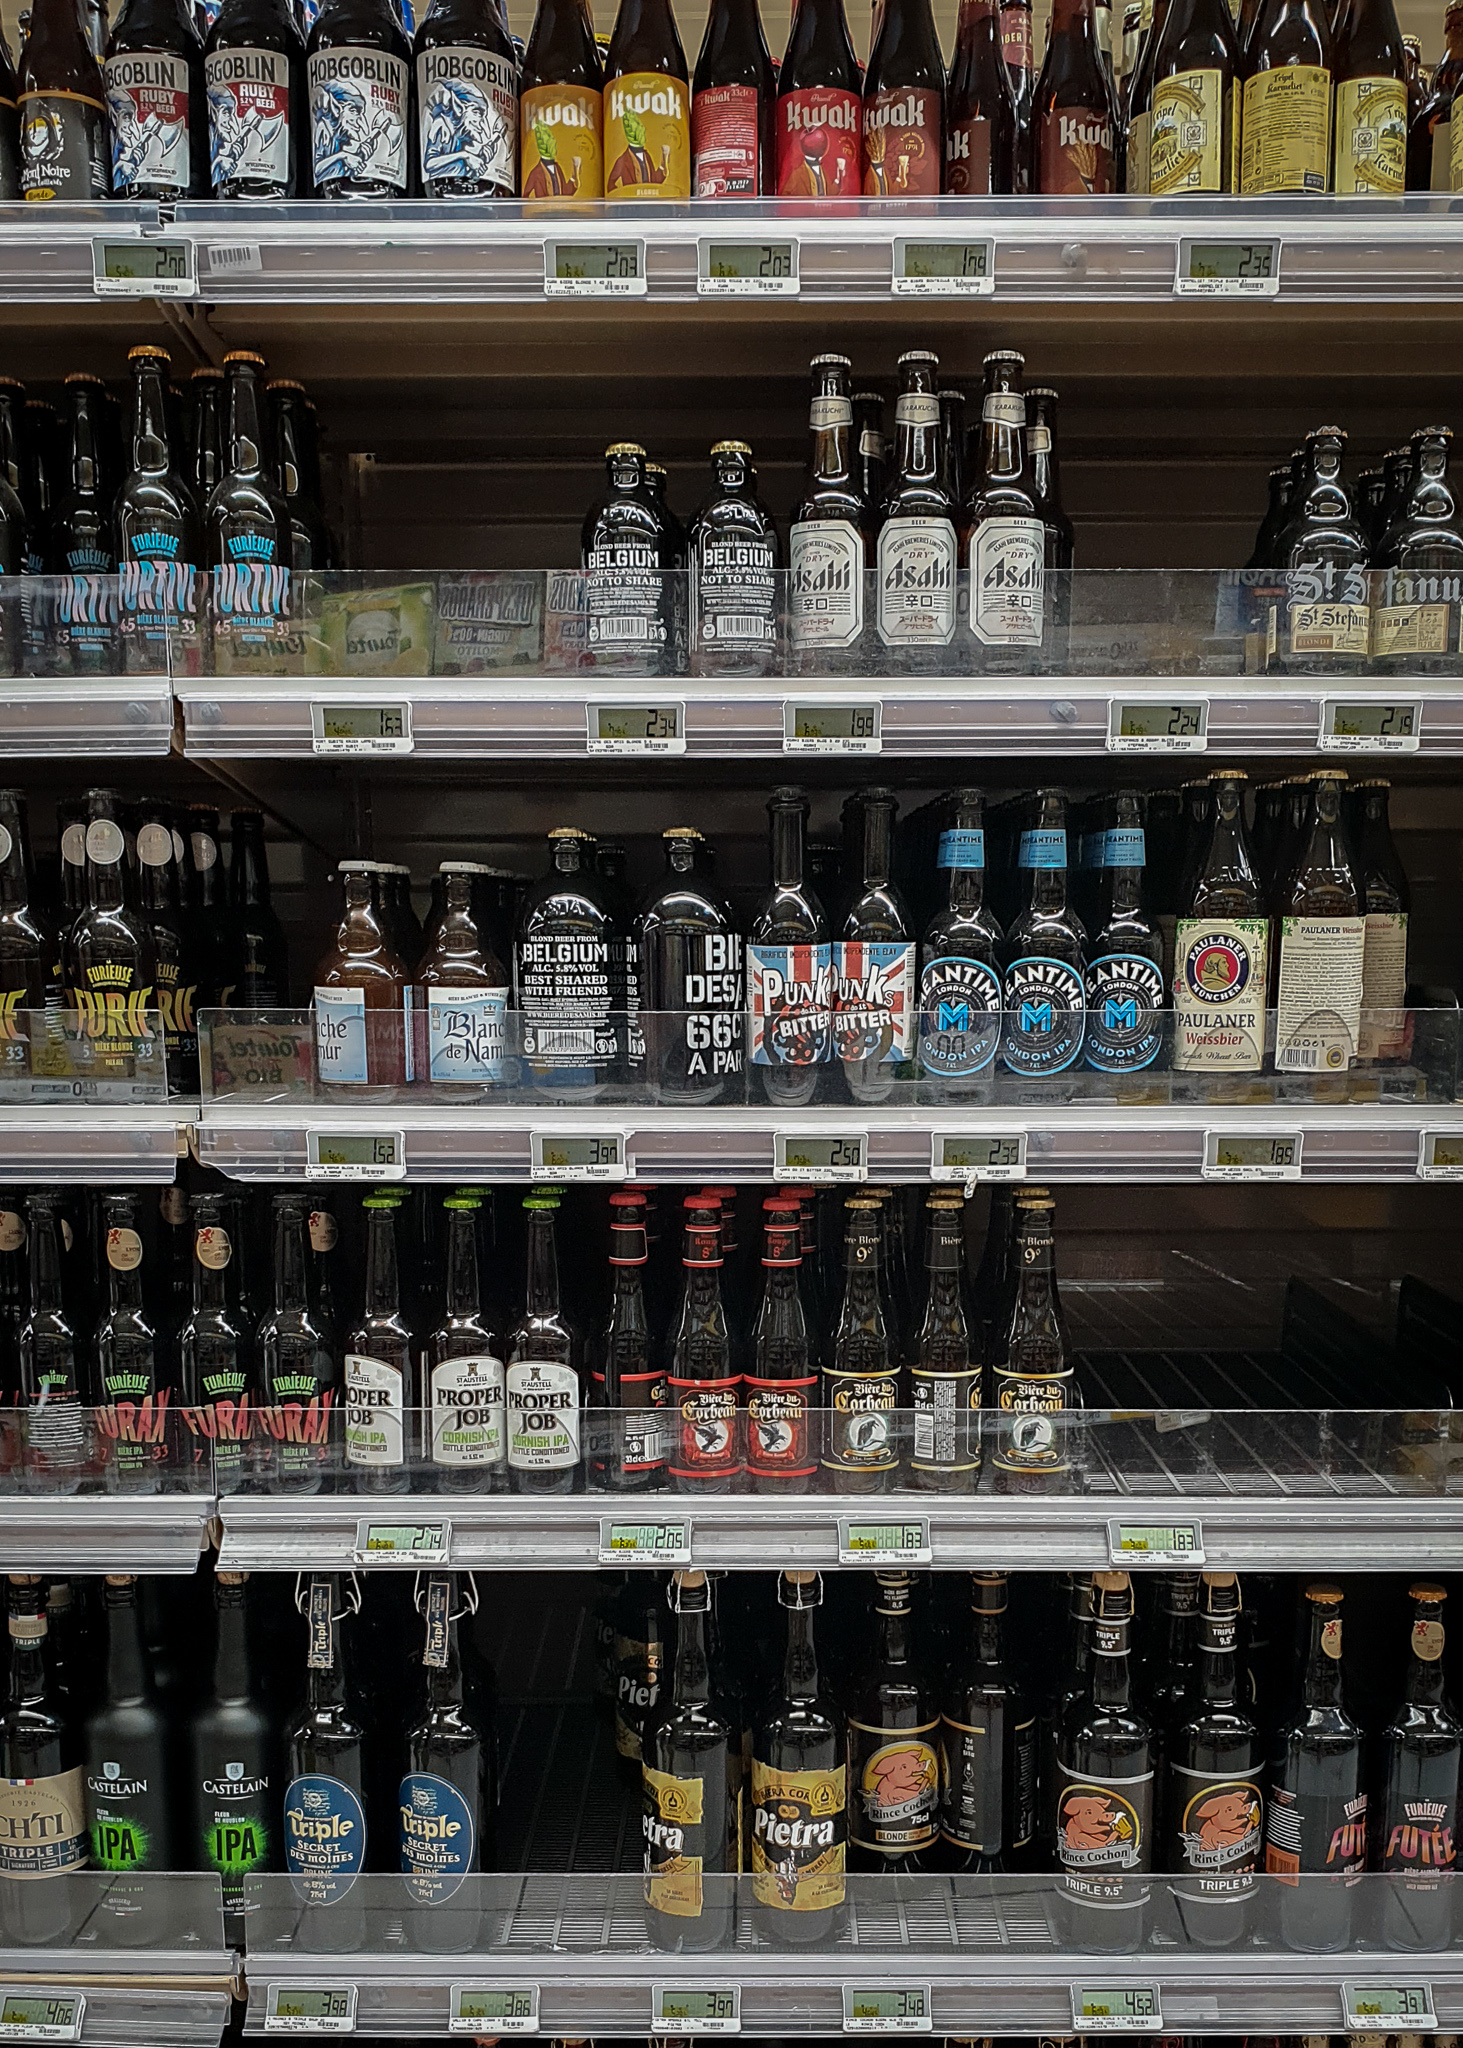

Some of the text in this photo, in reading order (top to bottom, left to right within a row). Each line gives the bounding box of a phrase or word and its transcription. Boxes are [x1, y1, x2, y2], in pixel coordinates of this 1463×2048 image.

[311, 56, 400, 89] HOBGOBLIN
[426, 55, 514, 95] HOBGOBLIN
[139, 89, 175, 105] RUBY
[240, 83, 275, 98] RUBY
[371, 84, 400, 102] RUBY
[155, 104, 176, 115] BEER
[256, 99, 275, 110] BEER
[131, 532, 179, 553] FURIEUSE
[228, 535, 275, 556] FURIEUSE
[589, 551, 659, 568] BELGIUM
[703, 550, 774, 568] BELGIUM
[587, 578, 604, 587] NOT
[626, 577, 662, 587] SHARE
[701, 575, 775, 586] NOT TO SHARE
[791, 559, 850, 594] Asahi
[885, 558, 950, 590] Asahi
[119, 561, 196, 613] FURTIVE
[214, 563, 290, 615] FURTIVE
[804, 598, 827, 611] 辛口
[906, 594, 932, 608] 辛口
[1007, 594, 1032, 608] 辛口
[1301, 926, 1341, 935] PAULANER
[523, 943, 607, 962] BELGIUM
[1189, 935, 1247, 961] PAULANER
[87, 966, 134, 983] FURIEUSE
[532, 964, 554, 972] ALC.
[556, 964, 578, 972] 5.8%
[525, 975, 607, 985] BEST SHARED
[1103, 981, 1139, 994] LONDON
[525, 987, 608, 996] WITH FRIENDS
[936, 983, 972, 995] LONDON
[1019, 983, 1055, 995] LONDON
[1191, 983, 1242, 1002] MÜNCHEN
[74, 986, 155, 1040] FURIE
[836, 1010, 891, 1032] BITTER
[1178, 1013, 1255, 1028] PAULANER
[1088, 1035, 1155, 1058] LONDON IPA
[1186, 1032, 1244, 1046] Weissbier
[6, 1046, 24, 1060] 33
[138, 1044, 152, 1058] 33
[447, 1043, 460, 1059] de
[923, 1036, 989, 1061] LONDON IPA
[1006, 1037, 1072, 1062] LONDON IPA
[106, 1372, 150, 1392] FURIEUSE
[203, 1372, 247, 1392] FURIEUSE
[273, 1372, 318, 1393] FURIEUSE
[436, 1386, 504, 1406] PROPER
[699, 1393, 735, 1403] Bière du
[761, 1393, 800, 1404] Bière du
[854, 1384, 895, 1397] Bière du
[1017, 1384, 1061, 1397] Bière du
[508, 1391, 574, 1410] PROPER
[835, 1391, 895, 1413] Corbeau
[1000, 1391, 1063, 1414] Corbeau
[681, 1401, 736, 1422] Corbeau
[748, 1399, 802, 1423] Corbeau
[454, 1408, 491, 1431] JOB
[520, 1412, 557, 1434] JOB
[370, 1432, 387, 1443] IPA
[442, 1428, 499, 1444] CORNISH IPA
[513, 1434, 569, 1448] CORNISH IPA
[465, 1440, 500, 1451] CONDITIONED
[531, 1446, 570, 1455] CONDITIONED
[1096, 1630, 1120, 1640] TRIPLE
[1212, 1627, 1236, 1636] TRIPLE
[15, 1638, 41, 1646] TRIPLE
[88, 1777, 147, 1794] CASTELAIN
[203, 1777, 268, 1795] CASTELAIN
[872, 1806, 900, 1819] Rince
[911, 1812, 929, 1824] 75cl
[1404, 1803, 1448, 1818] FURIEUSE
[754, 1807, 834, 1847] Pietra
[99, 1826, 137, 1860] IPA
[217, 1827, 257, 1861] IPA
[878, 1831, 908, 1841] BLONDE
[2, 1846, 53, 1858] TRIPLE
[298, 1840, 340, 1854] SECRET
[408, 1837, 447, 1853] SECRET
[1386, 1824, 1456, 1865] FUTÉE
[291, 1850, 304, 1861] DES
[1061, 1849, 1128, 1863] Rince Cochon
[1195, 1852, 1224, 1864] Rince
[1065, 1876, 1101, 1896] TRIPLE
[1199, 1878, 1240, 1890] TRIPLE
